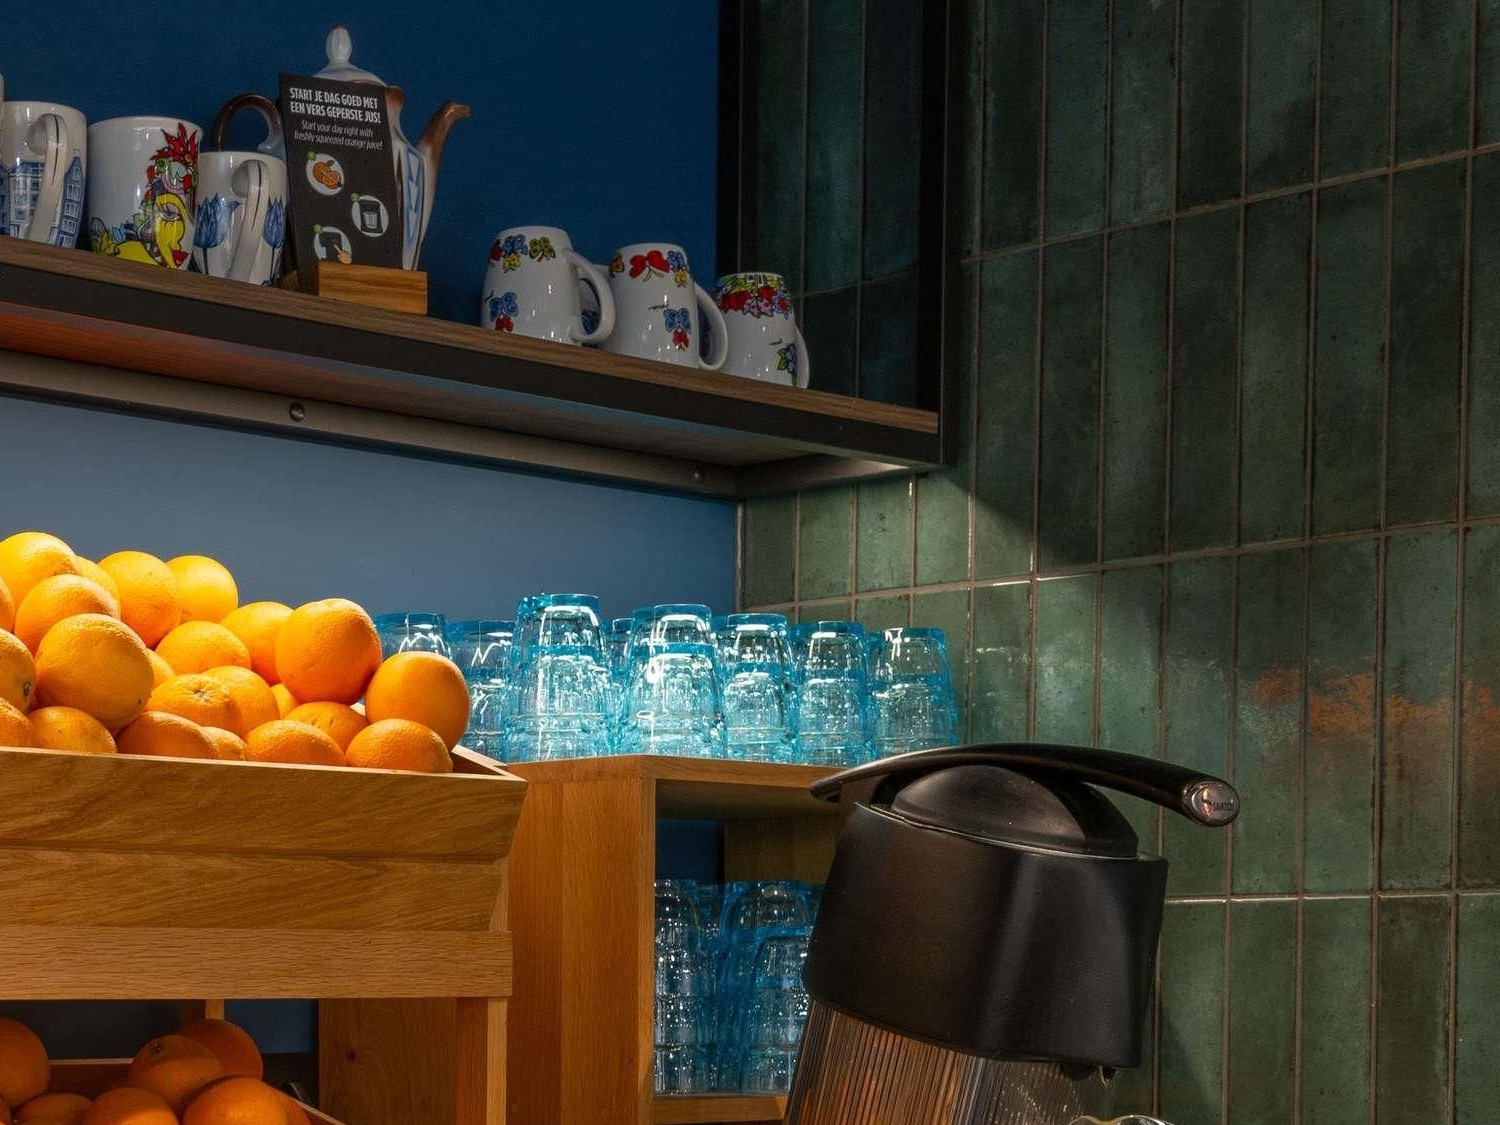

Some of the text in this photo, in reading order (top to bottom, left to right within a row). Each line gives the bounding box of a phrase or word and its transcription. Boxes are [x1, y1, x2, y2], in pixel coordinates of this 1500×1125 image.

[290, 88, 378, 110] START JE DAG GOED MET
[290, 102, 381, 124] EEN VERS GEPERSTE JUS!
[294, 130, 315, 143] freshly
[316, 134, 344, 146] squeezed
[301, 120, 374, 138] Start your day right with
